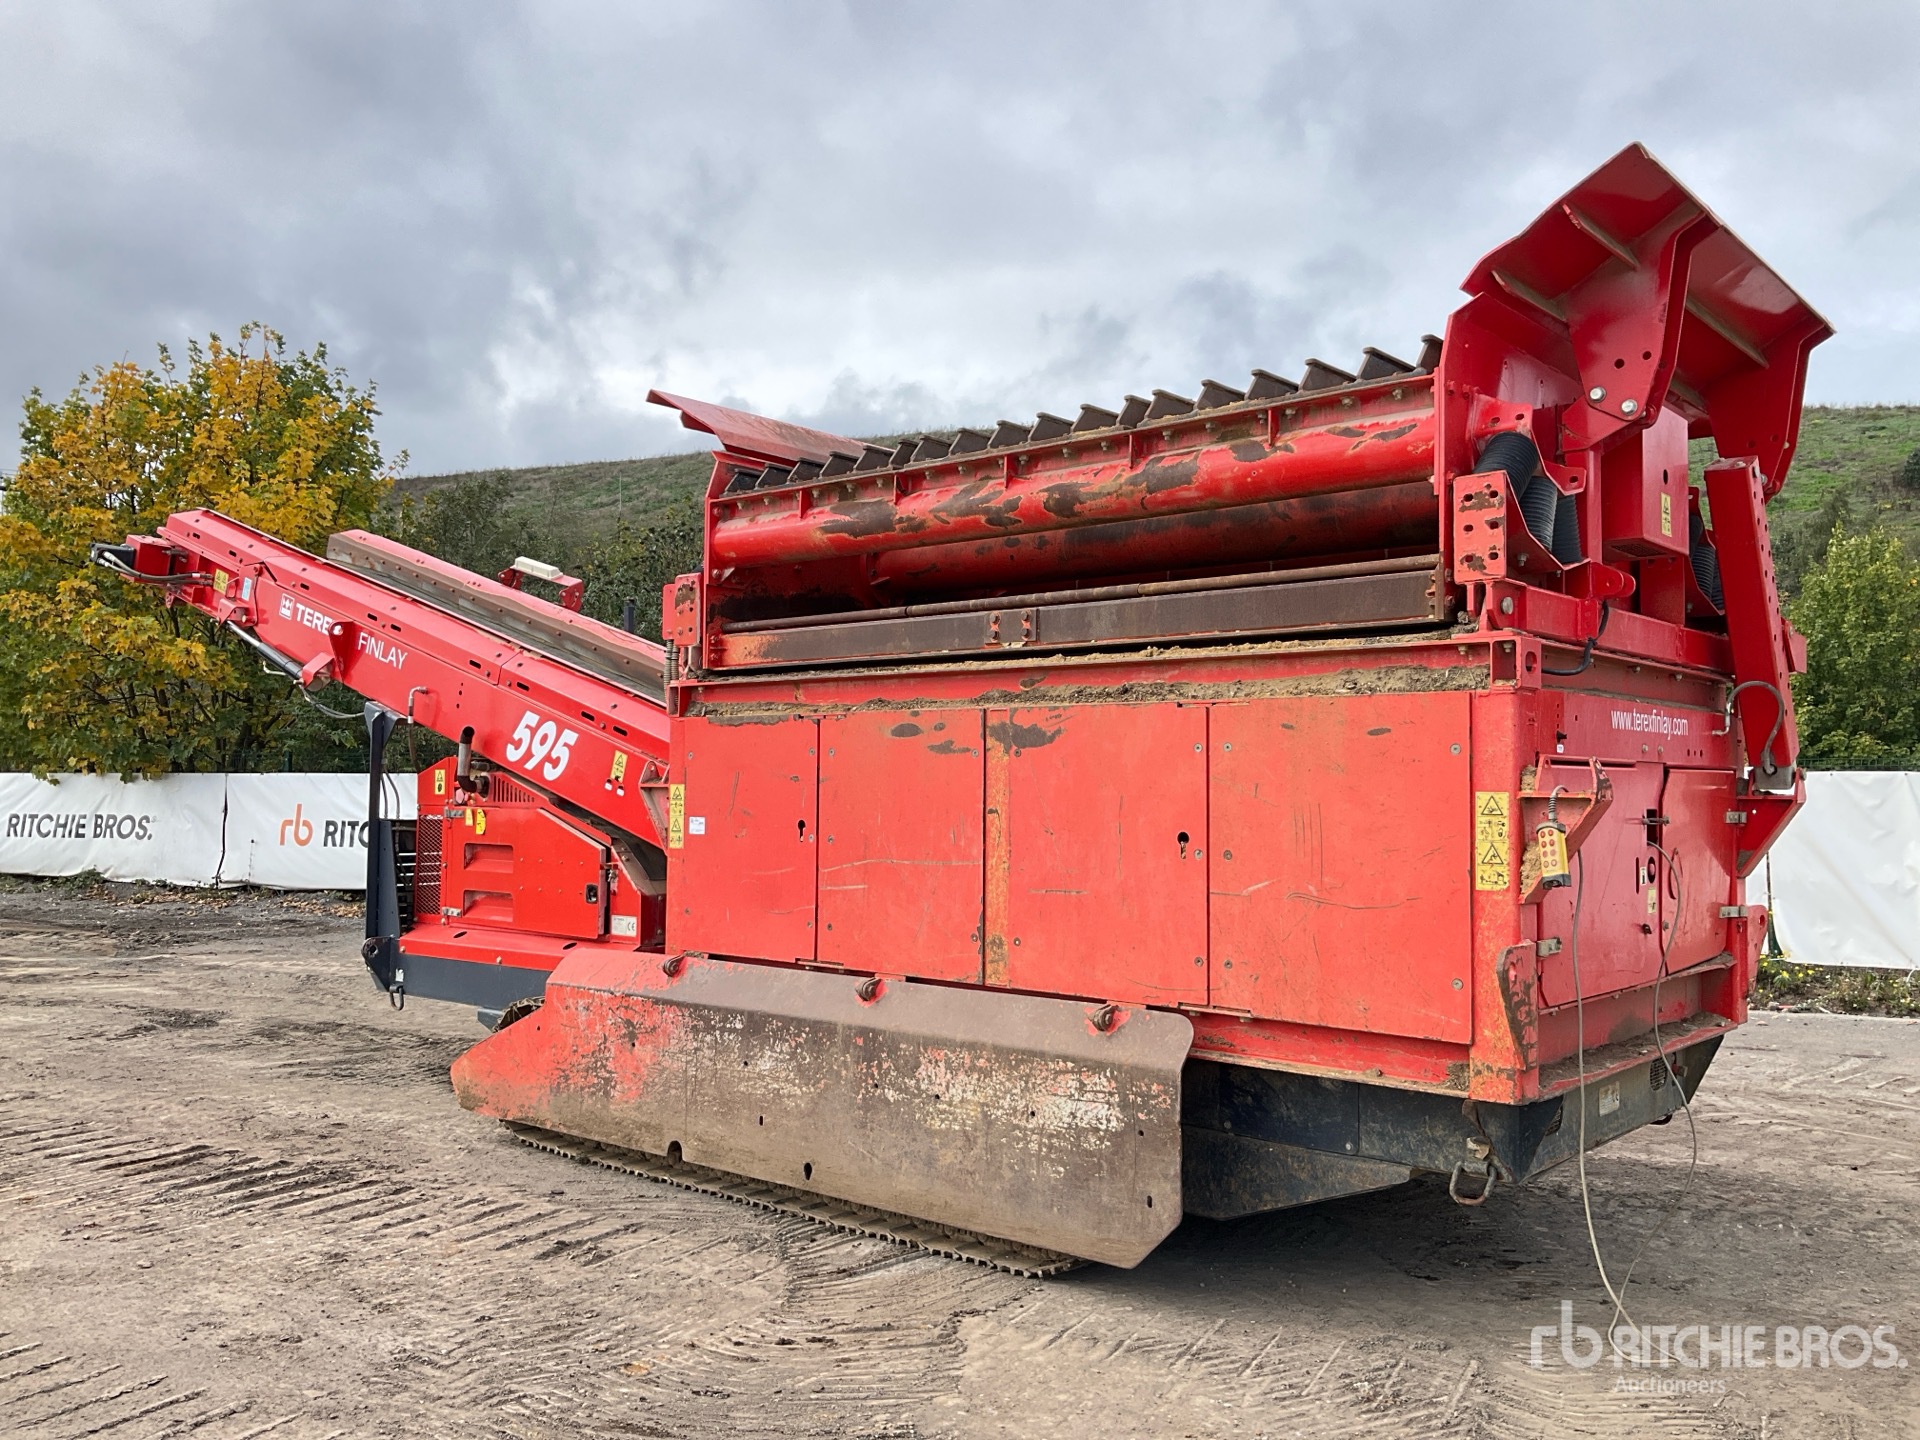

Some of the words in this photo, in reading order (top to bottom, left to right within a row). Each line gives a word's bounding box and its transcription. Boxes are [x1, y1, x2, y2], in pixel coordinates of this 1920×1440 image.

[295, 603, 336, 636] TERE
[358, 631, 408, 670] FINLAY
[1611, 708, 1689, 740] www.terexfinlay.com
[506, 710, 579, 781] 595
[6, 813, 87, 838] RITCHIE
[92, 814, 153, 840] BROS.
